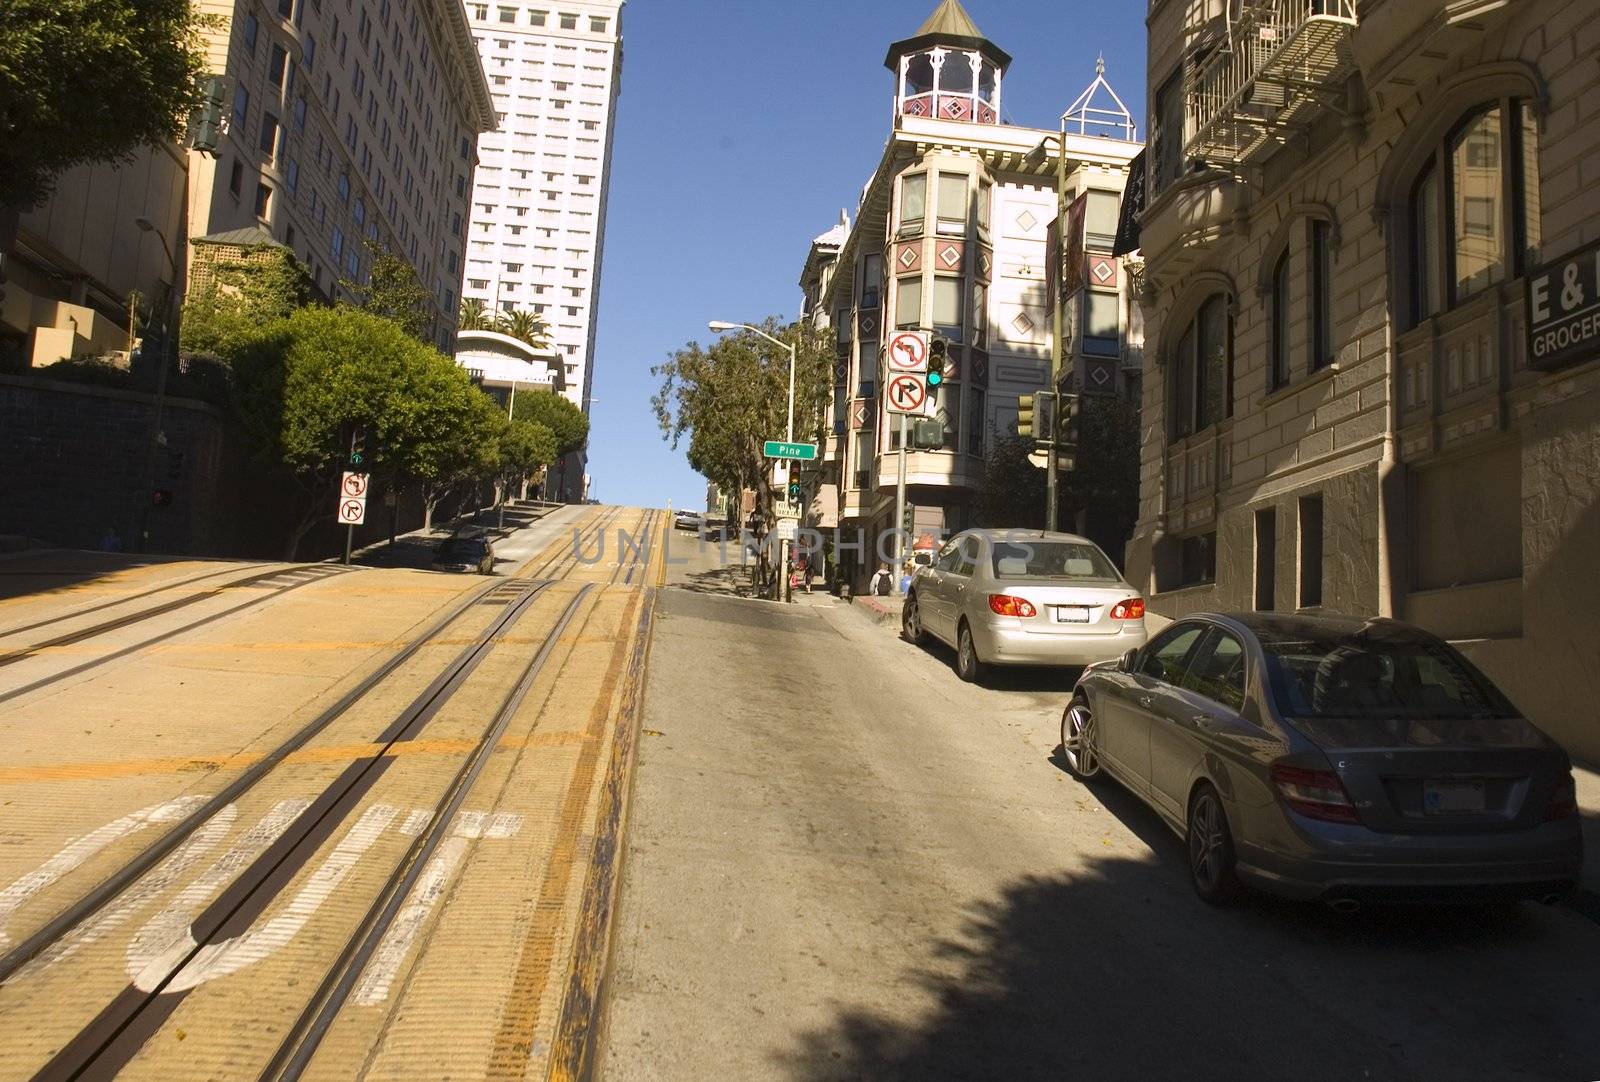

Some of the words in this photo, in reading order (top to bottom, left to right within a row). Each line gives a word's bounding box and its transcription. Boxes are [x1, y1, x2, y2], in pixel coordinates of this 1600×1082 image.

[1531, 274, 1550, 324] E
[1560, 261, 1585, 311] &
[779, 445, 801, 456] Pine
